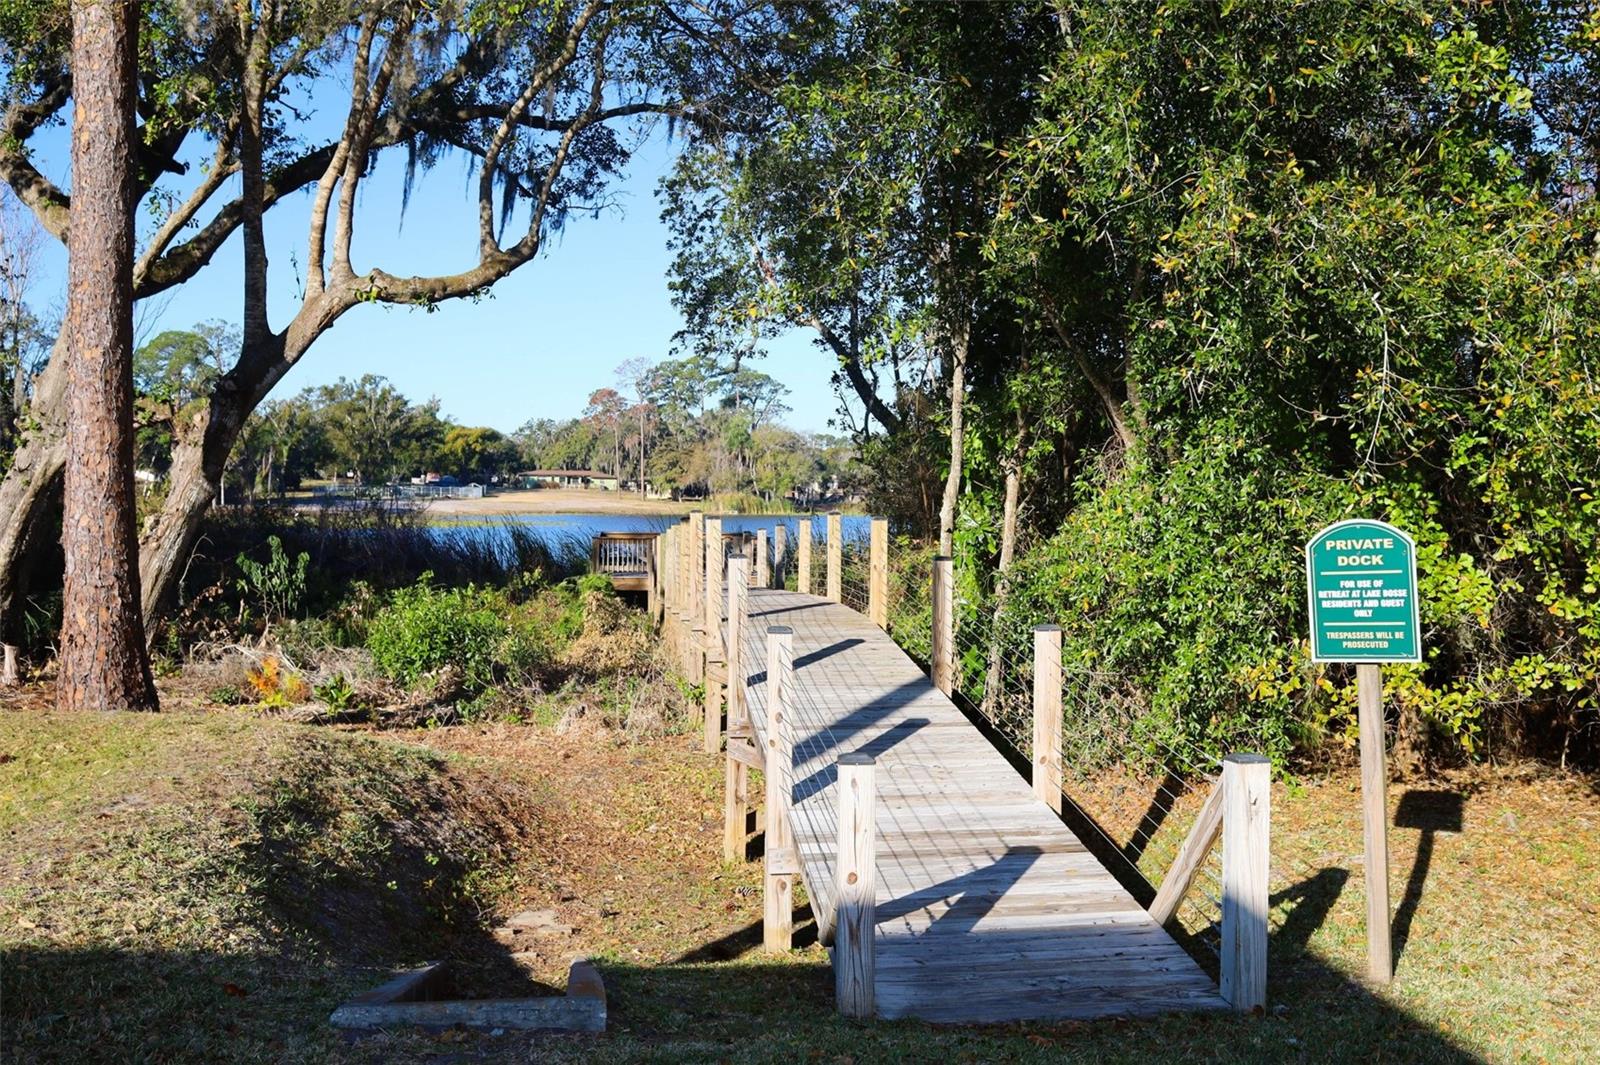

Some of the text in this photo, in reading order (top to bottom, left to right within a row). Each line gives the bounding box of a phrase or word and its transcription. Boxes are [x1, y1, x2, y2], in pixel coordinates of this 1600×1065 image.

[1325, 538, 1394, 551] PRIVATE
[1337, 554, 1384, 566] DOCK
[1340, 579, 1384, 588] FOR USE OF
[1318, 590, 1350, 599] RETREAT
[1351, 590, 1361, 598] AT
[1362, 590, 1381, 598] LAKE
[1321, 599, 1405, 608] RESIDENTS AND GUEST
[1353, 609, 1373, 617] ONLY
[1326, 631, 1404, 640] TRESPASSERS WILL BE
[1342, 641, 1389, 649] PROSECUTED
